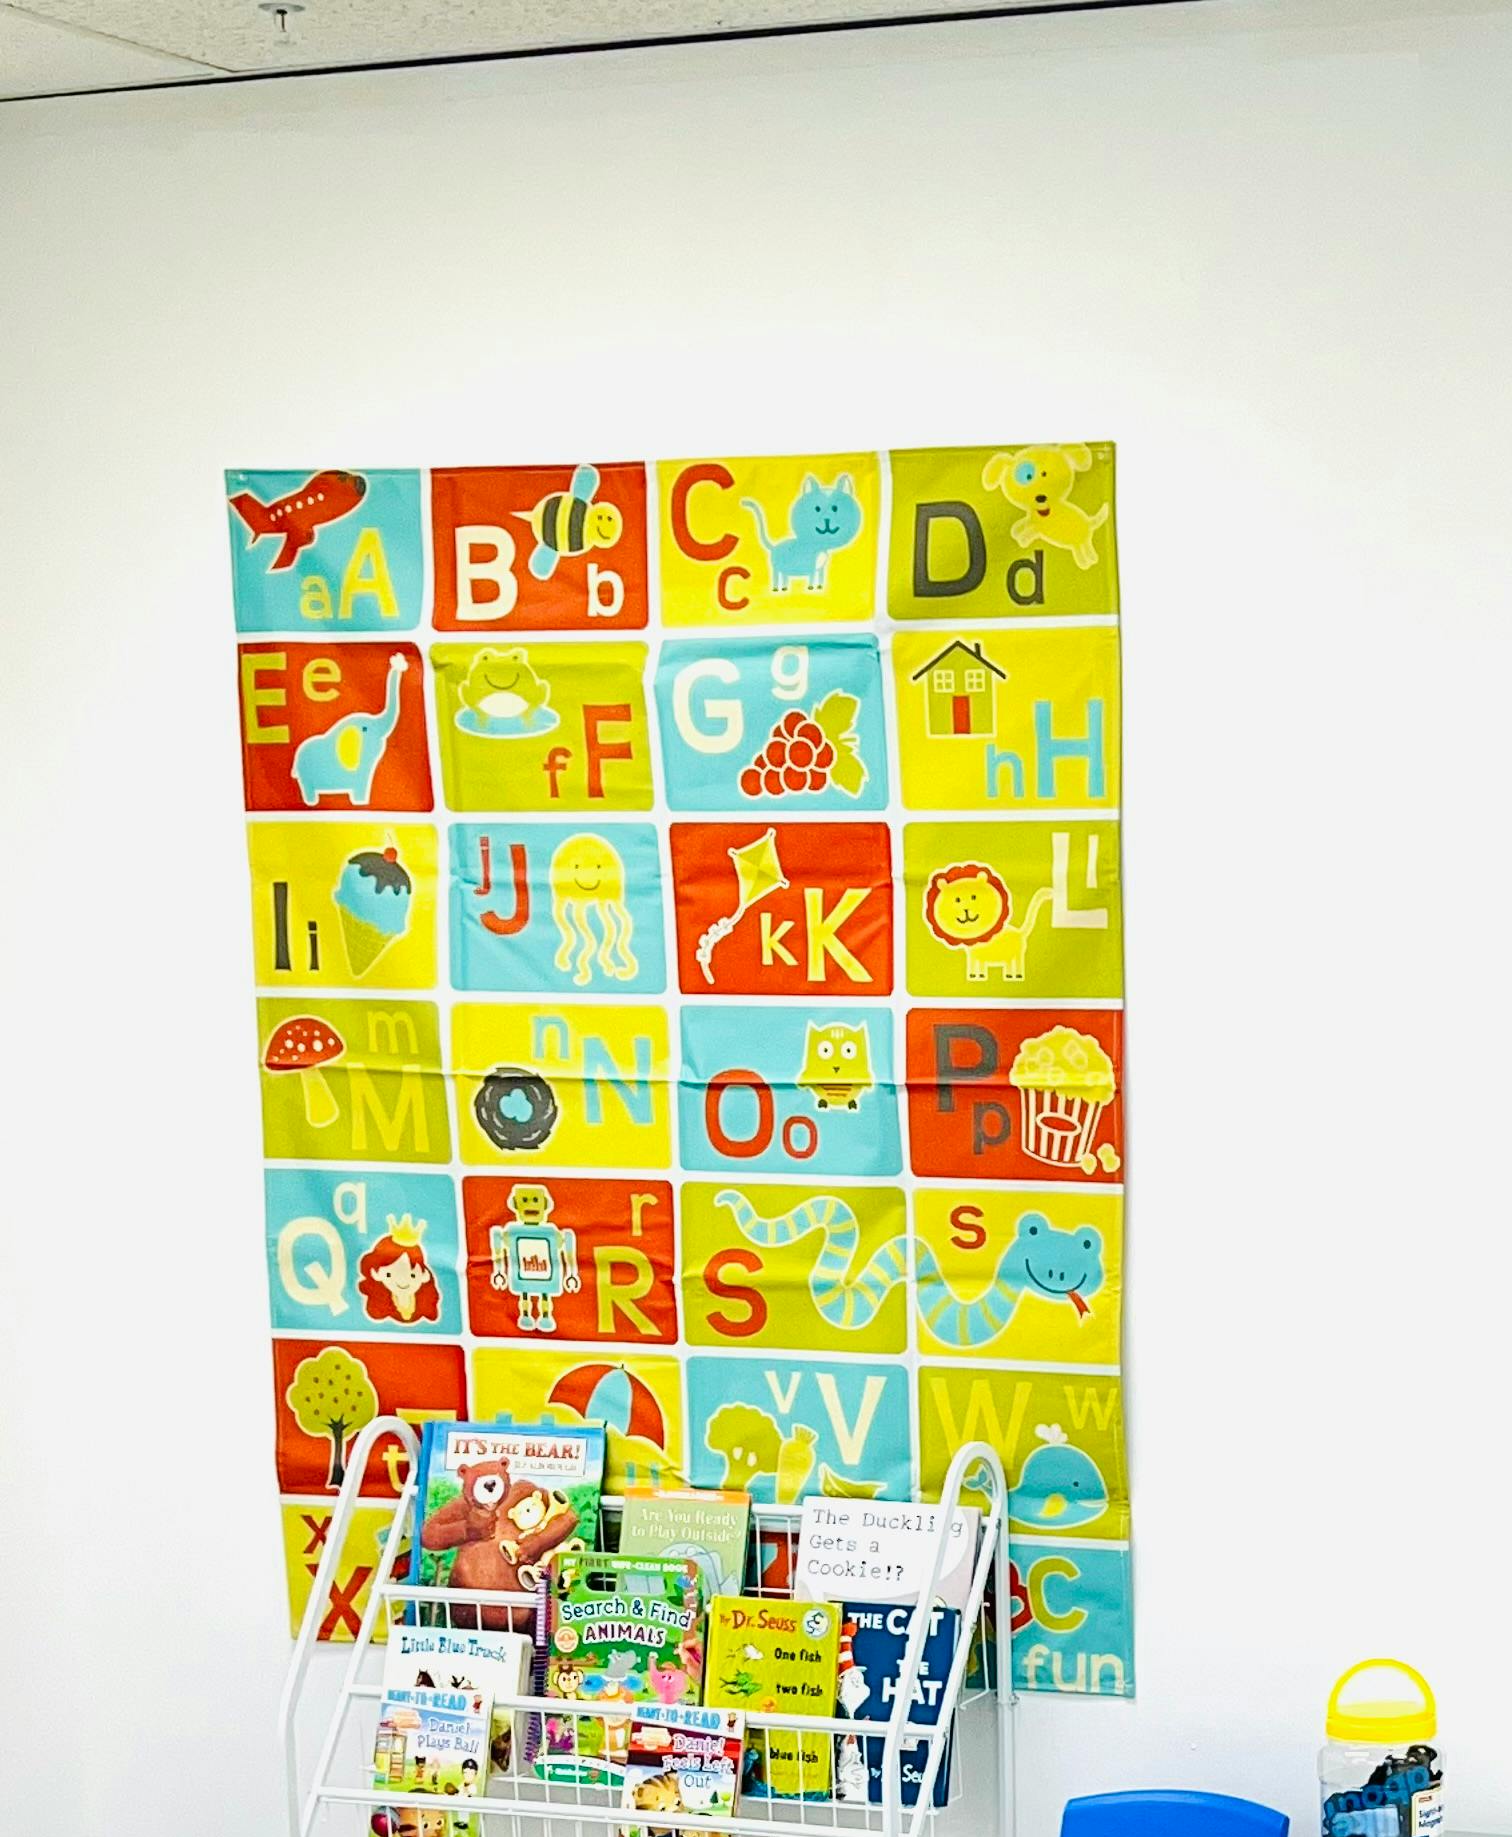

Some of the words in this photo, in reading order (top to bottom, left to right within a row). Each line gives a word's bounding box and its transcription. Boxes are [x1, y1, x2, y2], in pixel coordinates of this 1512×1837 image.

[454, 1439, 487, 1455] IT'S
[492, 1443, 519, 1454] THE
[524, 1442, 580, 1459] BEAR!
[641, 1508, 662, 1521] Are
[667, 1509, 690, 1523] You
[695, 1510, 737, 1529] Ready
[813, 1509, 849, 1525] The
[862, 1512, 963, 1537] Ducklig
[631, 1525, 645, 1537] to
[649, 1525, 676, 1541] Play
[809, 1534, 856, 1552] Gets
[869, 1540, 880, 1553] a
[807, 1559, 904, 1582] Cookie!?
[562, 1598, 625, 1621] Search
[633, 1599, 643, 1615] &
[651, 1603, 691, 1628] Find
[758, 1609, 796, 1633] Seuss
[848, 1612, 883, 1629] THE
[886, 1609, 944, 1637] CT
[586, 1625, 664, 1645] ANIMALS
[401, 1636, 435, 1654] Little
[438, 1637, 466, 1654] Blue
[468, 1639, 507, 1663] Truck
[775, 1648, 795, 1661] One
[800, 1648, 821, 1663] fish
[1023, 1644, 1124, 1693] fun
[417, 1733, 451, 1750] Plays
[454, 1735, 479, 1754] Ball
[673, 1733, 726, 1757] Daniel
[684, 1774, 711, 1789] Out
